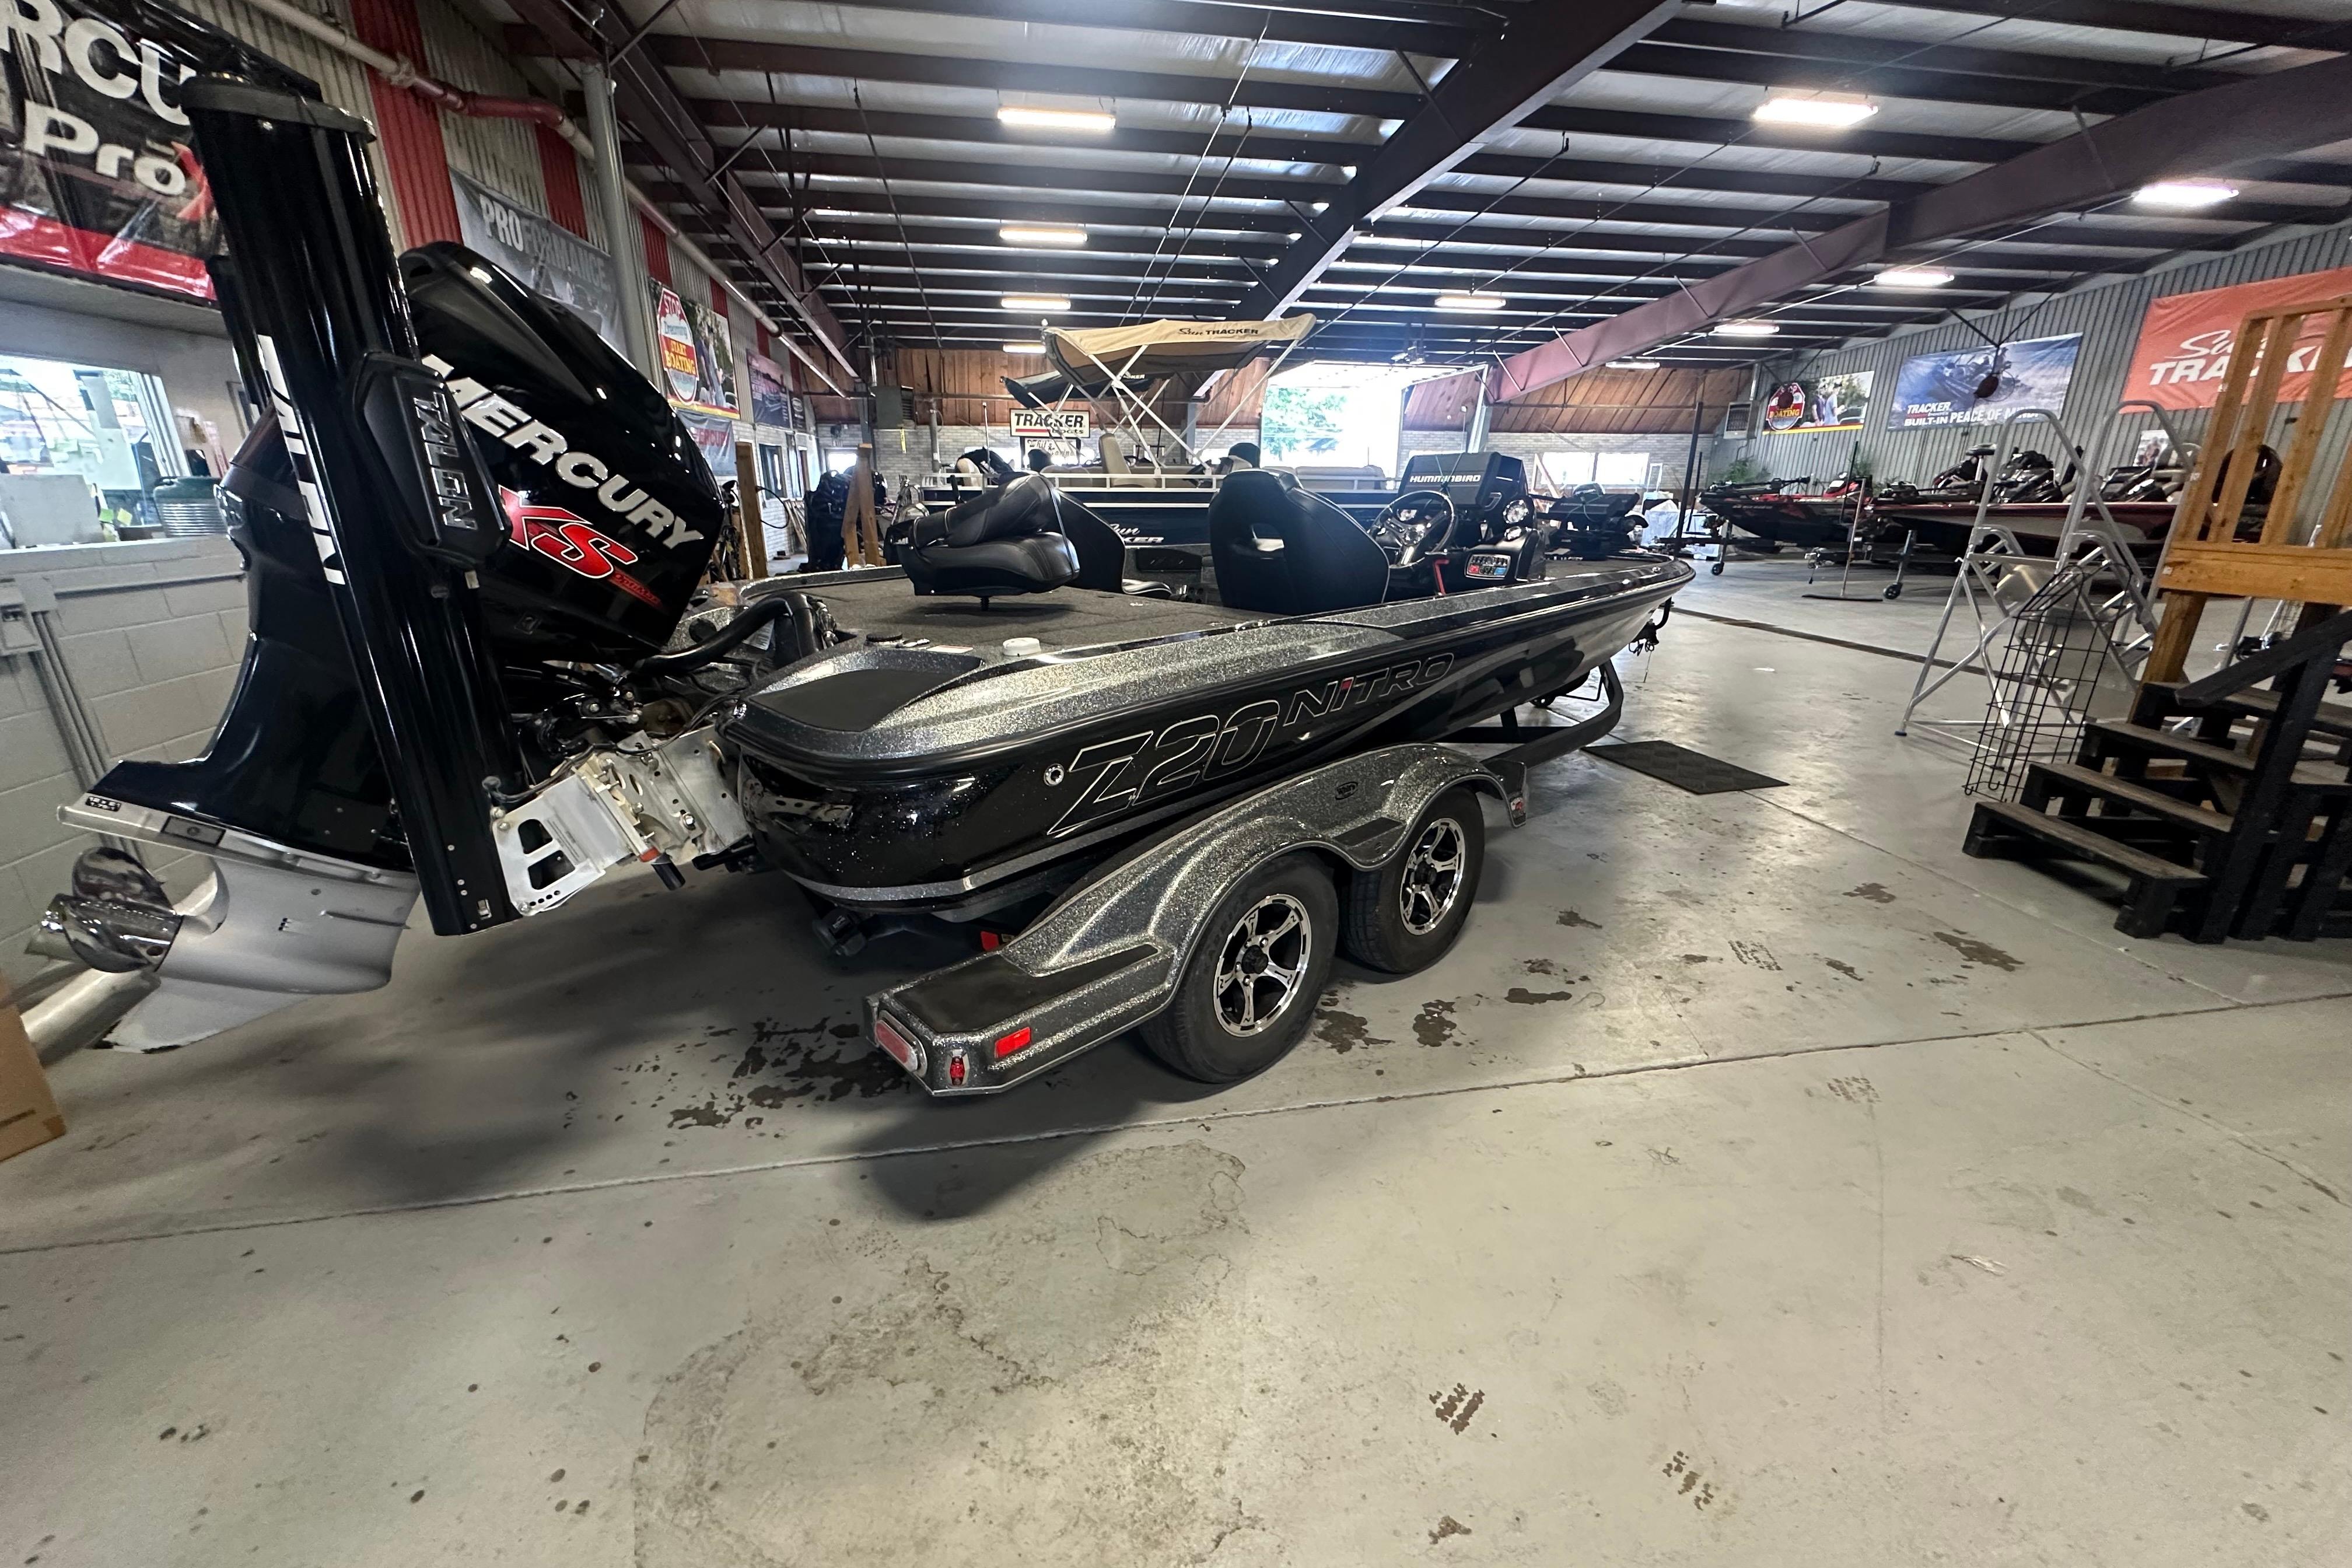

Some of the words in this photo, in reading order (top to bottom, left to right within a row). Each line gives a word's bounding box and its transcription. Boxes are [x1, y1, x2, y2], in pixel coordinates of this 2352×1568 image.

[24, 99, 186, 196] Pro
[664, 294, 681, 316] STOP
[665, 350, 696, 376] BOATING
[1903, 416, 1948, 426] BUILT-IN
[1949, 410, 1985, 424] PEACE
[1987, 408, 2003, 421] OF
[1906, 401, 1951, 414] TRACKER
[1014, 413, 1084, 428] TRACKER
[1409, 475, 1482, 483] HUMMINBIRD
[499, 484, 638, 579] XS
[1046, 699, 1280, 838] Z20
[1282, 652, 1454, 727] NITRO
